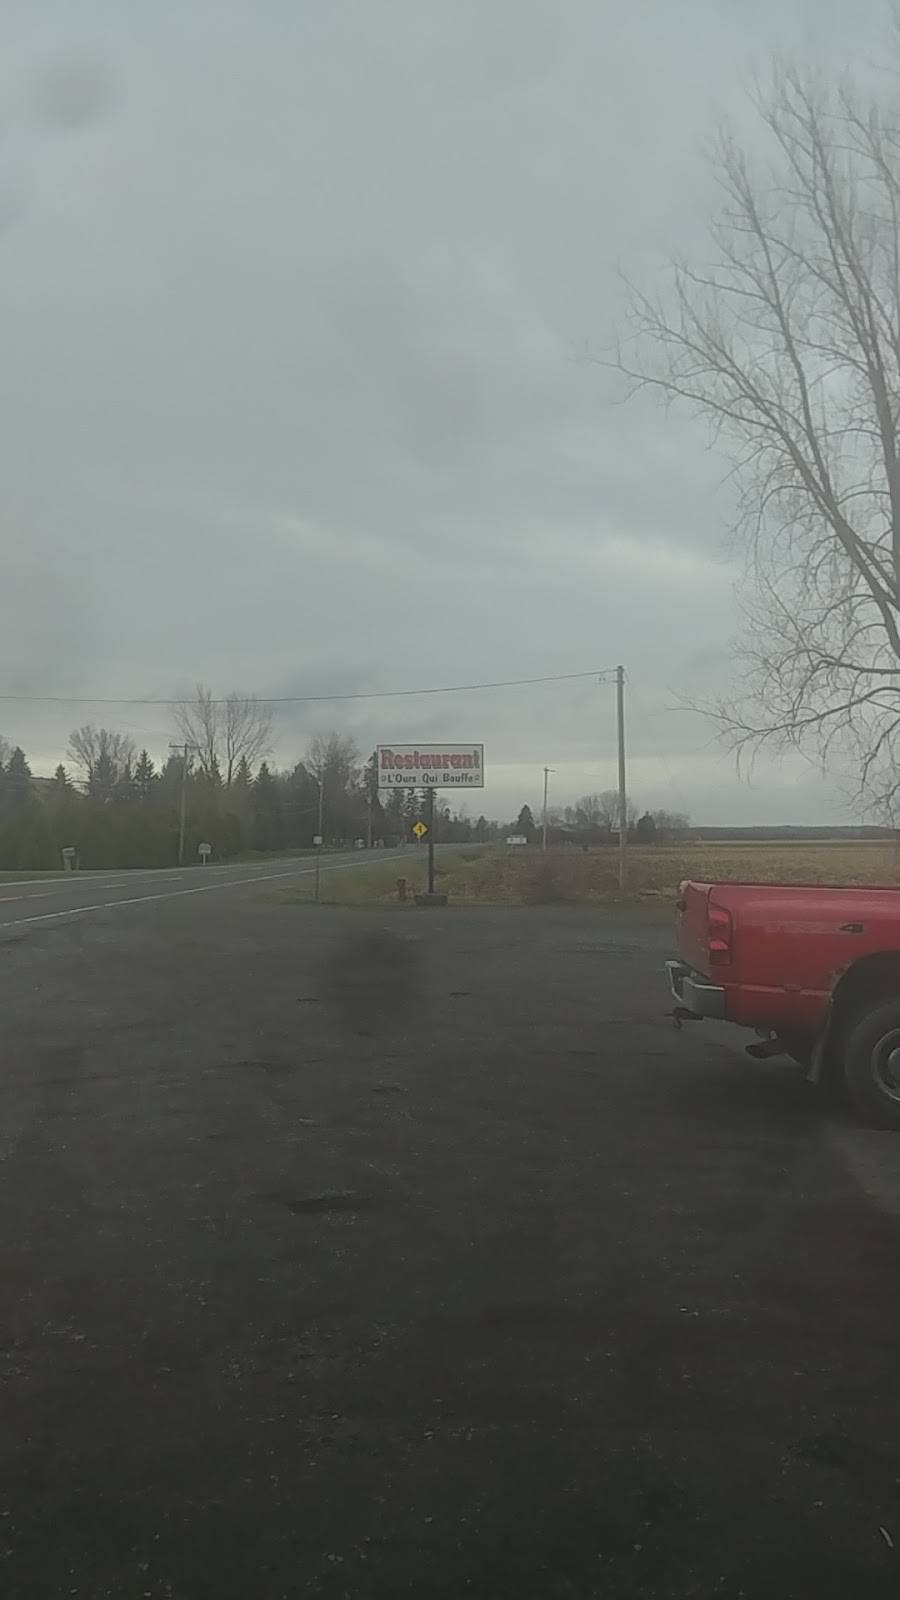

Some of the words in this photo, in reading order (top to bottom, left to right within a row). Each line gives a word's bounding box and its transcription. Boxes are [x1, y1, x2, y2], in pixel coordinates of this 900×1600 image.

[381, 749, 480, 769] Restaurant
[387, 773, 417, 783] L'Ours
[422, 773, 438, 783] Qui
